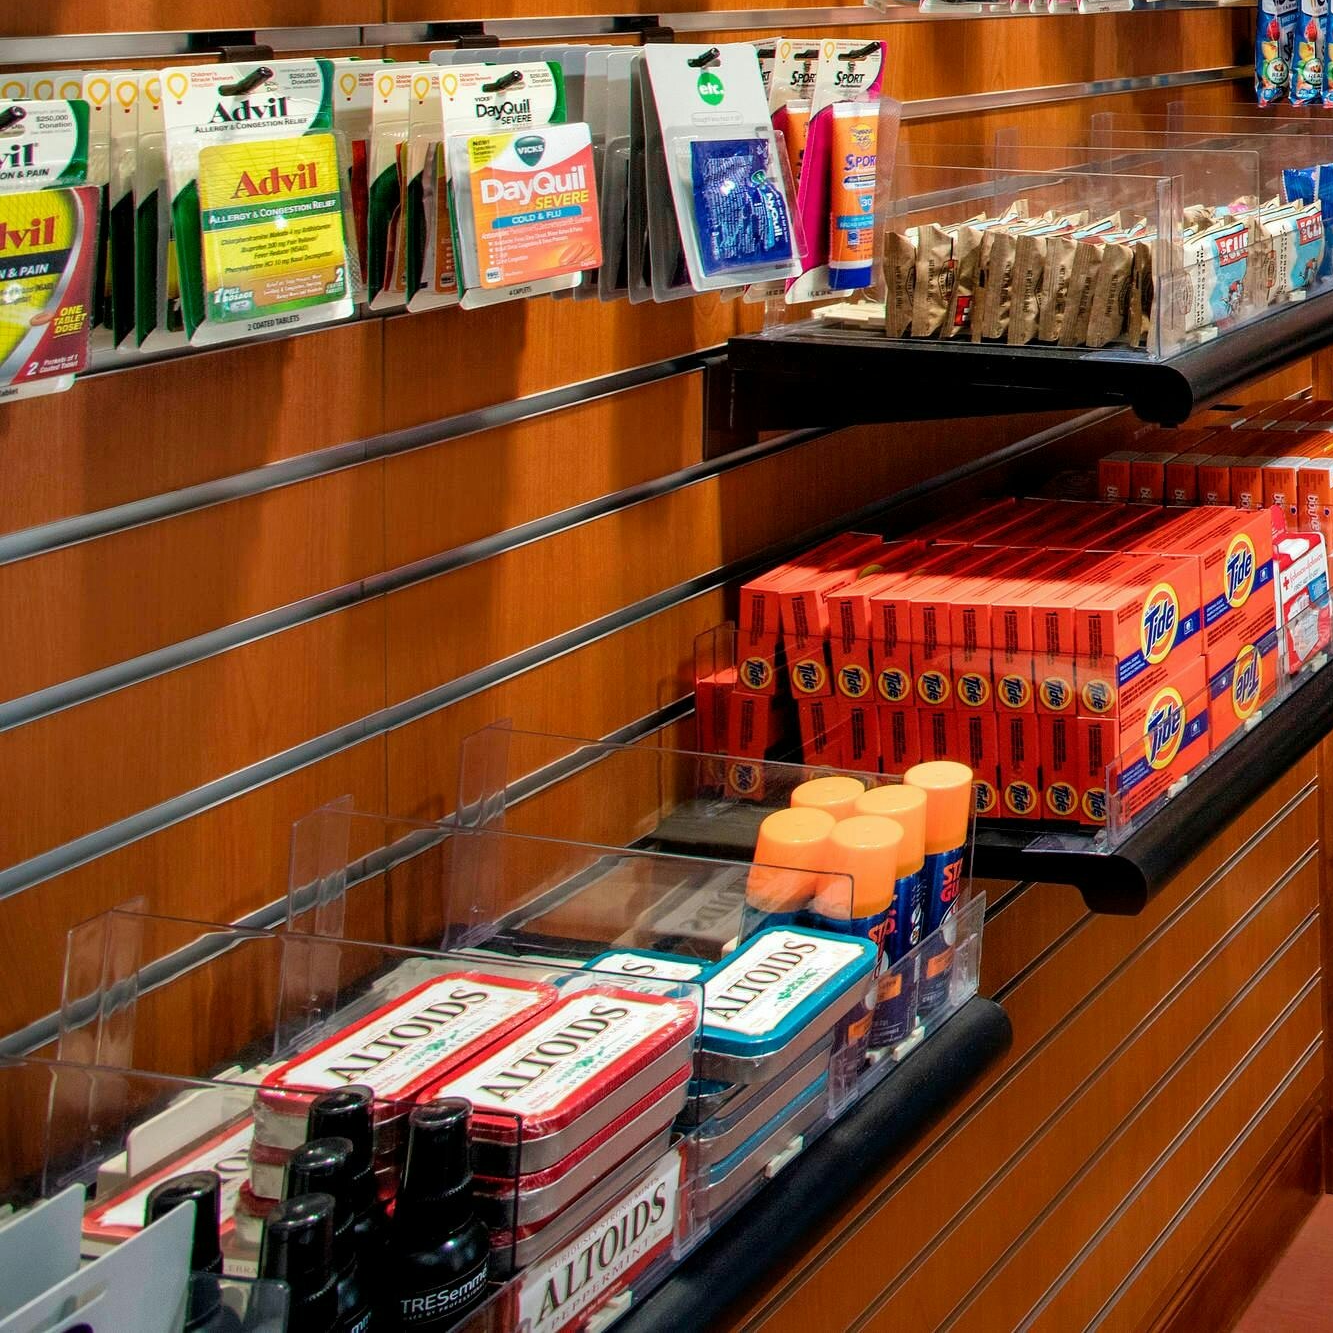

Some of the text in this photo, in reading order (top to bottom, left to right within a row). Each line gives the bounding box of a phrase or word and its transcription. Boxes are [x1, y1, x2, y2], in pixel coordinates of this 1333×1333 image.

[835, 71, 865, 85] SPORT
[699, 82, 724, 95] etc.
[210, 97, 288, 124] Advil
[477, 99, 530, 120] DayQuil
[195, 117, 308, 134] ALLERGY CONGESTION RELIEF
[501, 114, 532, 125] SEVERE
[517, 145, 544, 154] VICKS
[230, 162, 319, 199] Advil
[481, 165, 586, 206] DayQuil
[536, 191, 589, 208] SEVERE
[209, 198, 336, 224] ALLERGY CONGESTION RELIEF
[512, 210, 561, 224] COLD FLU
[18, 263, 49, 276] PAIN
[53, 313, 87, 326] TABLET
[60, 306, 83, 316] ONE
[56, 322, 83, 334] DOSE!
[253, 315, 300, 330] COATED TABLETS
[1227, 551, 1252, 603] Tide
[1145, 602, 1175, 657] Tide
[705, 937, 818, 1019] ALTOIDS
[328, 988, 489, 1083] ALTOIDS
[479, 1004, 631, 1100] ALTOIDS
[533, 1181, 667, 1329] ALTOIDS
[551, 1238, 651, 1331] PEPPERMINT
